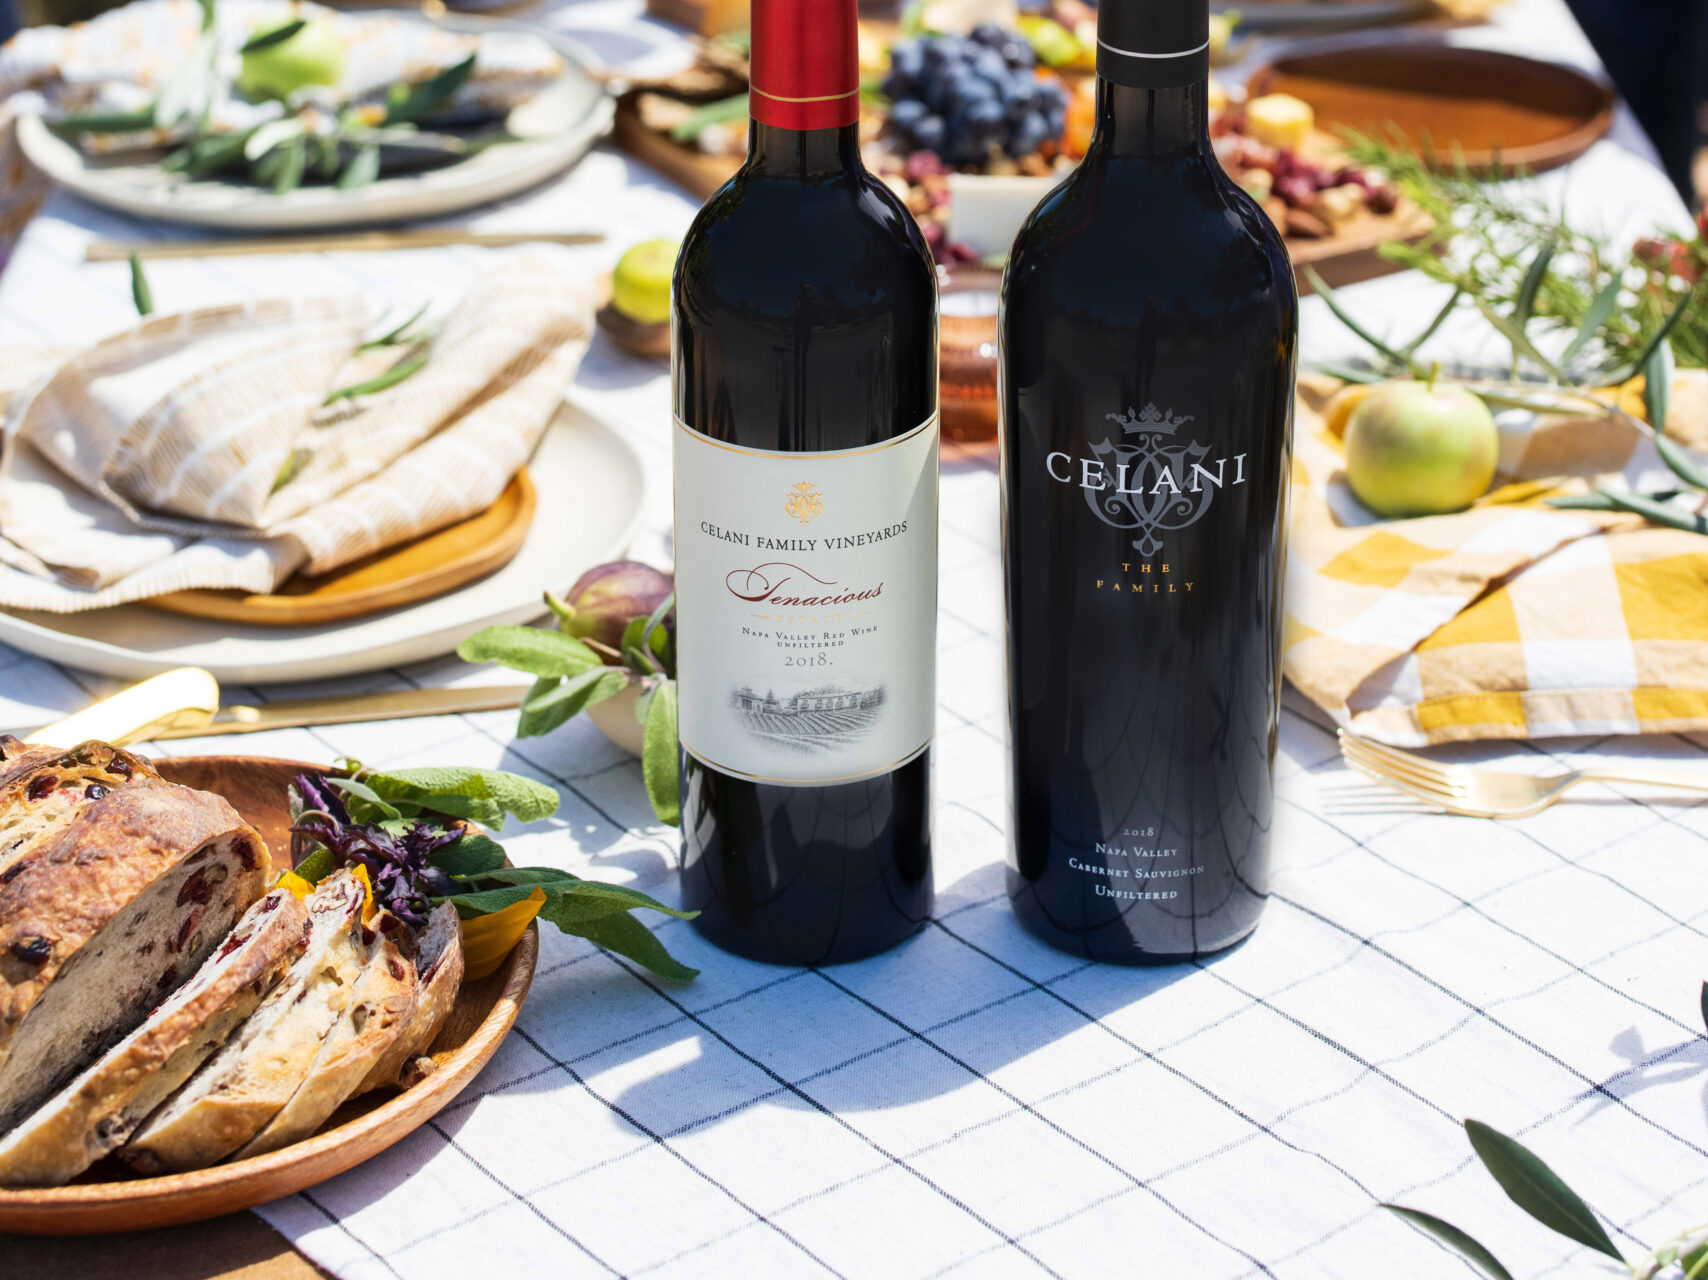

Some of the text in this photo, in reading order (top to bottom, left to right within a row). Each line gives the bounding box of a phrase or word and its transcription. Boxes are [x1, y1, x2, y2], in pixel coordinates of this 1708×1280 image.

[1046, 451, 1247, 495] CELANI
[700, 520, 908, 551] CELANI FAMILY VINEYARDS
[1121, 562, 1170, 573] THE
[726, 562, 884, 606] Tenacious
[1096, 579, 1194, 593] FAMILY
[776, 613, 843, 625] ESTATE
[777, 640, 844, 649] UNFILTERED
[1122, 827, 1154, 837] 2018
